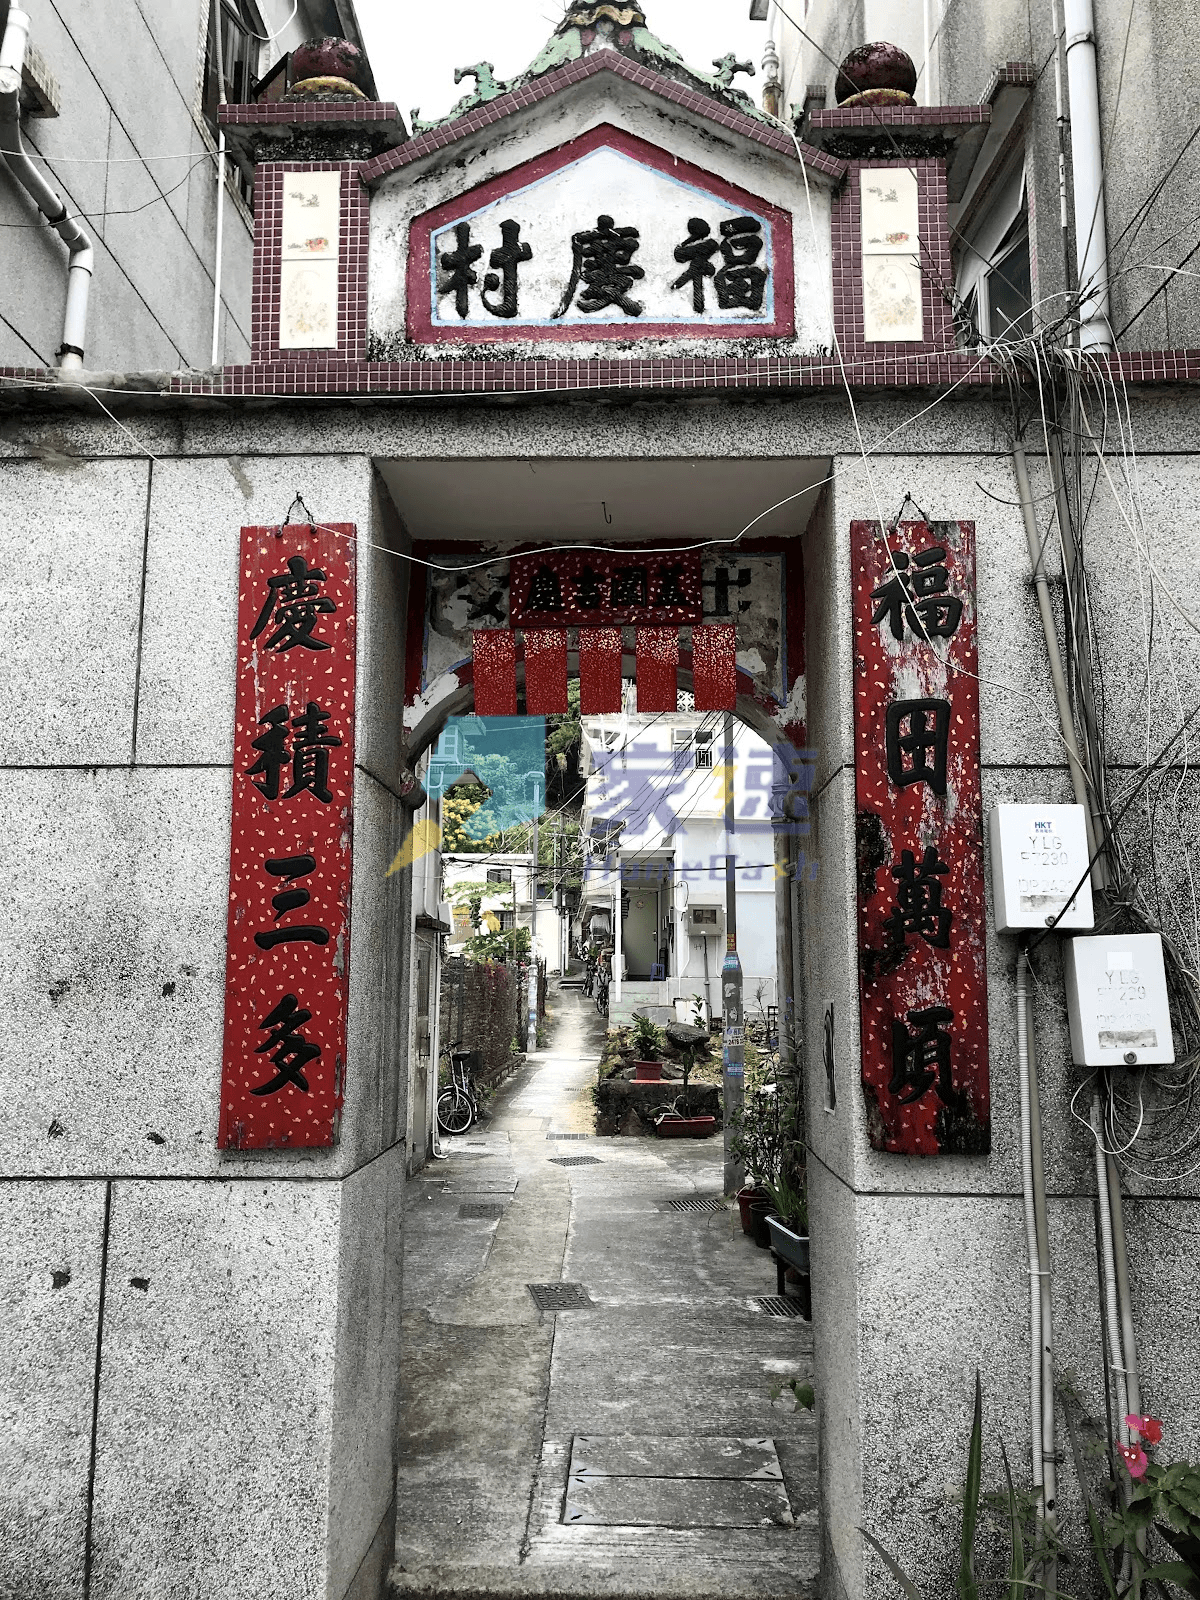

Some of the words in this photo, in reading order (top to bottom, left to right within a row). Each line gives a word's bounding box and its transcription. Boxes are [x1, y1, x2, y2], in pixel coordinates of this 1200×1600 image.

[437, 214, 768, 319] 福慶村
[243, 555, 343, 1098] 慶積三多
[1034, 821, 1052, 829] HKT
